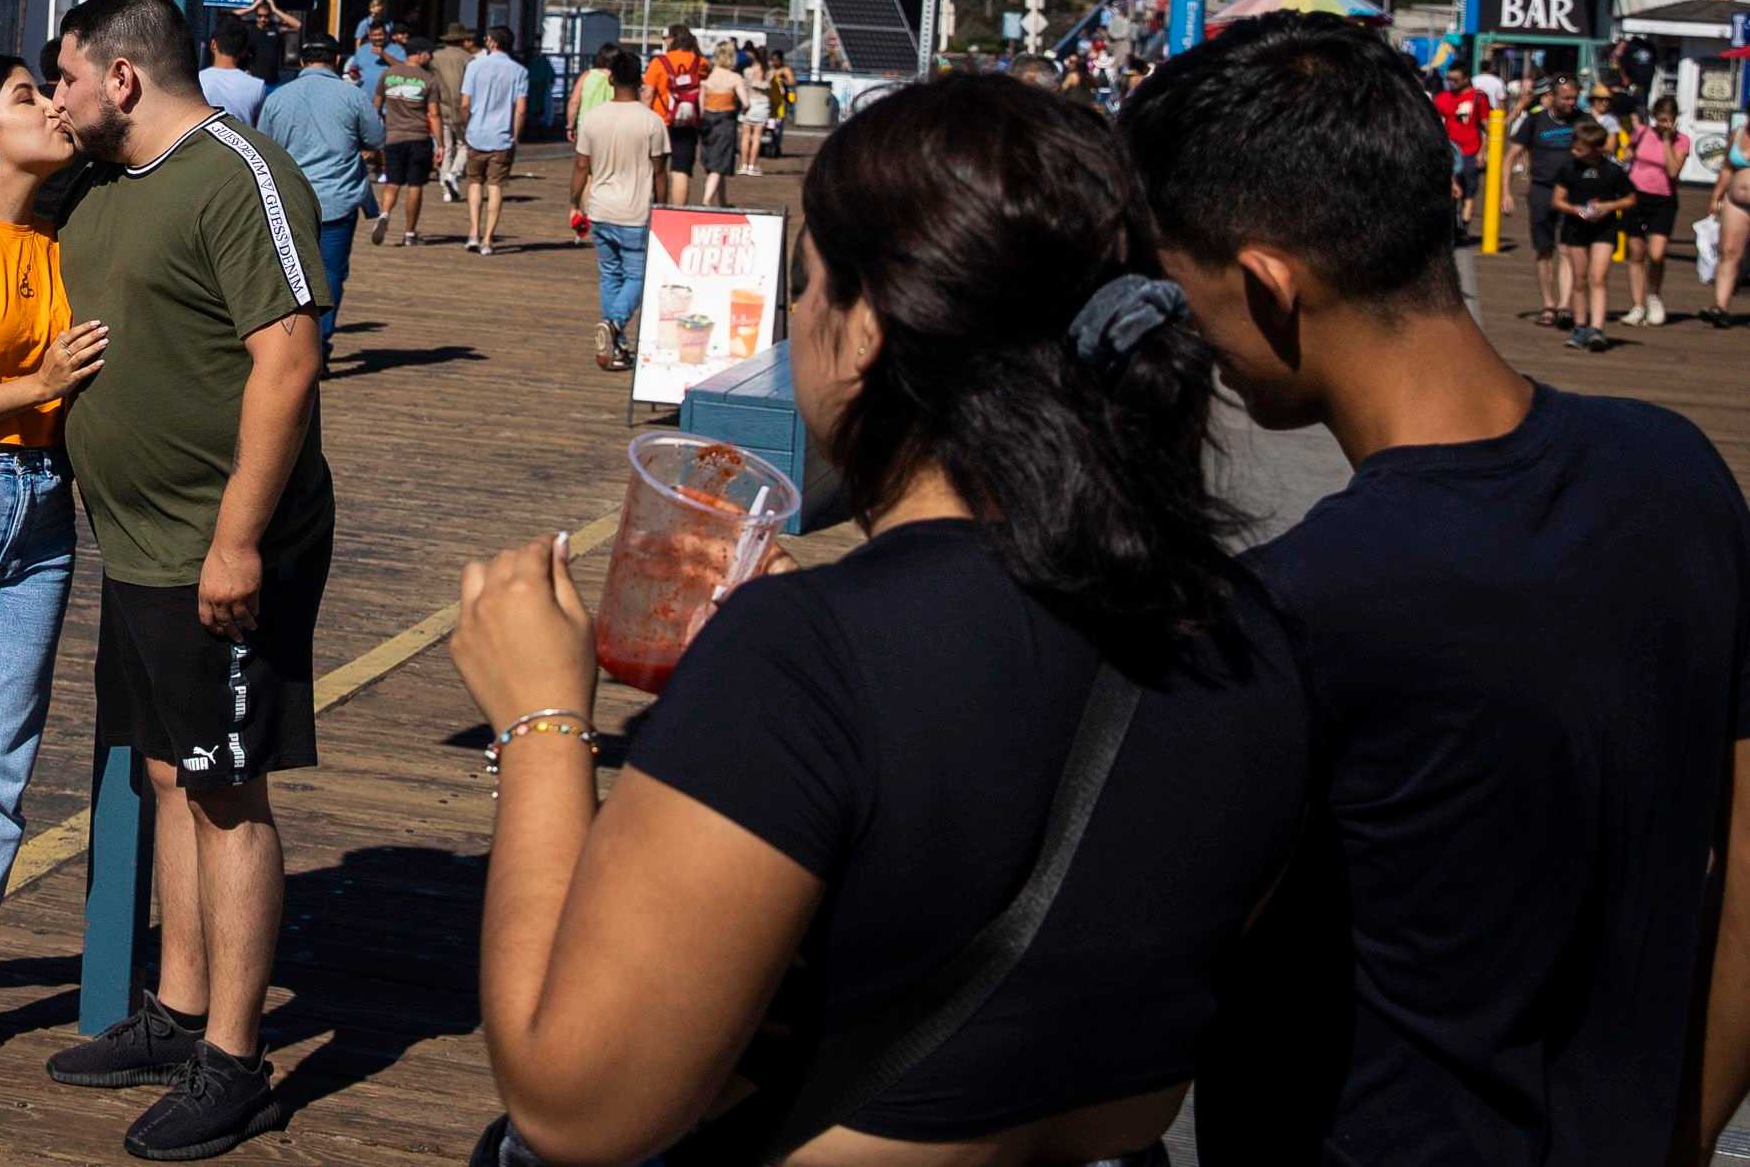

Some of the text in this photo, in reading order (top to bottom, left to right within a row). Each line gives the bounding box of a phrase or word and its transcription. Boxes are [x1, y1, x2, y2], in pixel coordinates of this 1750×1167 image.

[1181, 0, 1200, 50] Emerg
[211, 126, 269, 176] GUESS DENIM
[266, 194, 304, 295] GUESS DENIM
[681, 245, 756, 275] OPEN
[228, 733, 245, 768] PUMA
